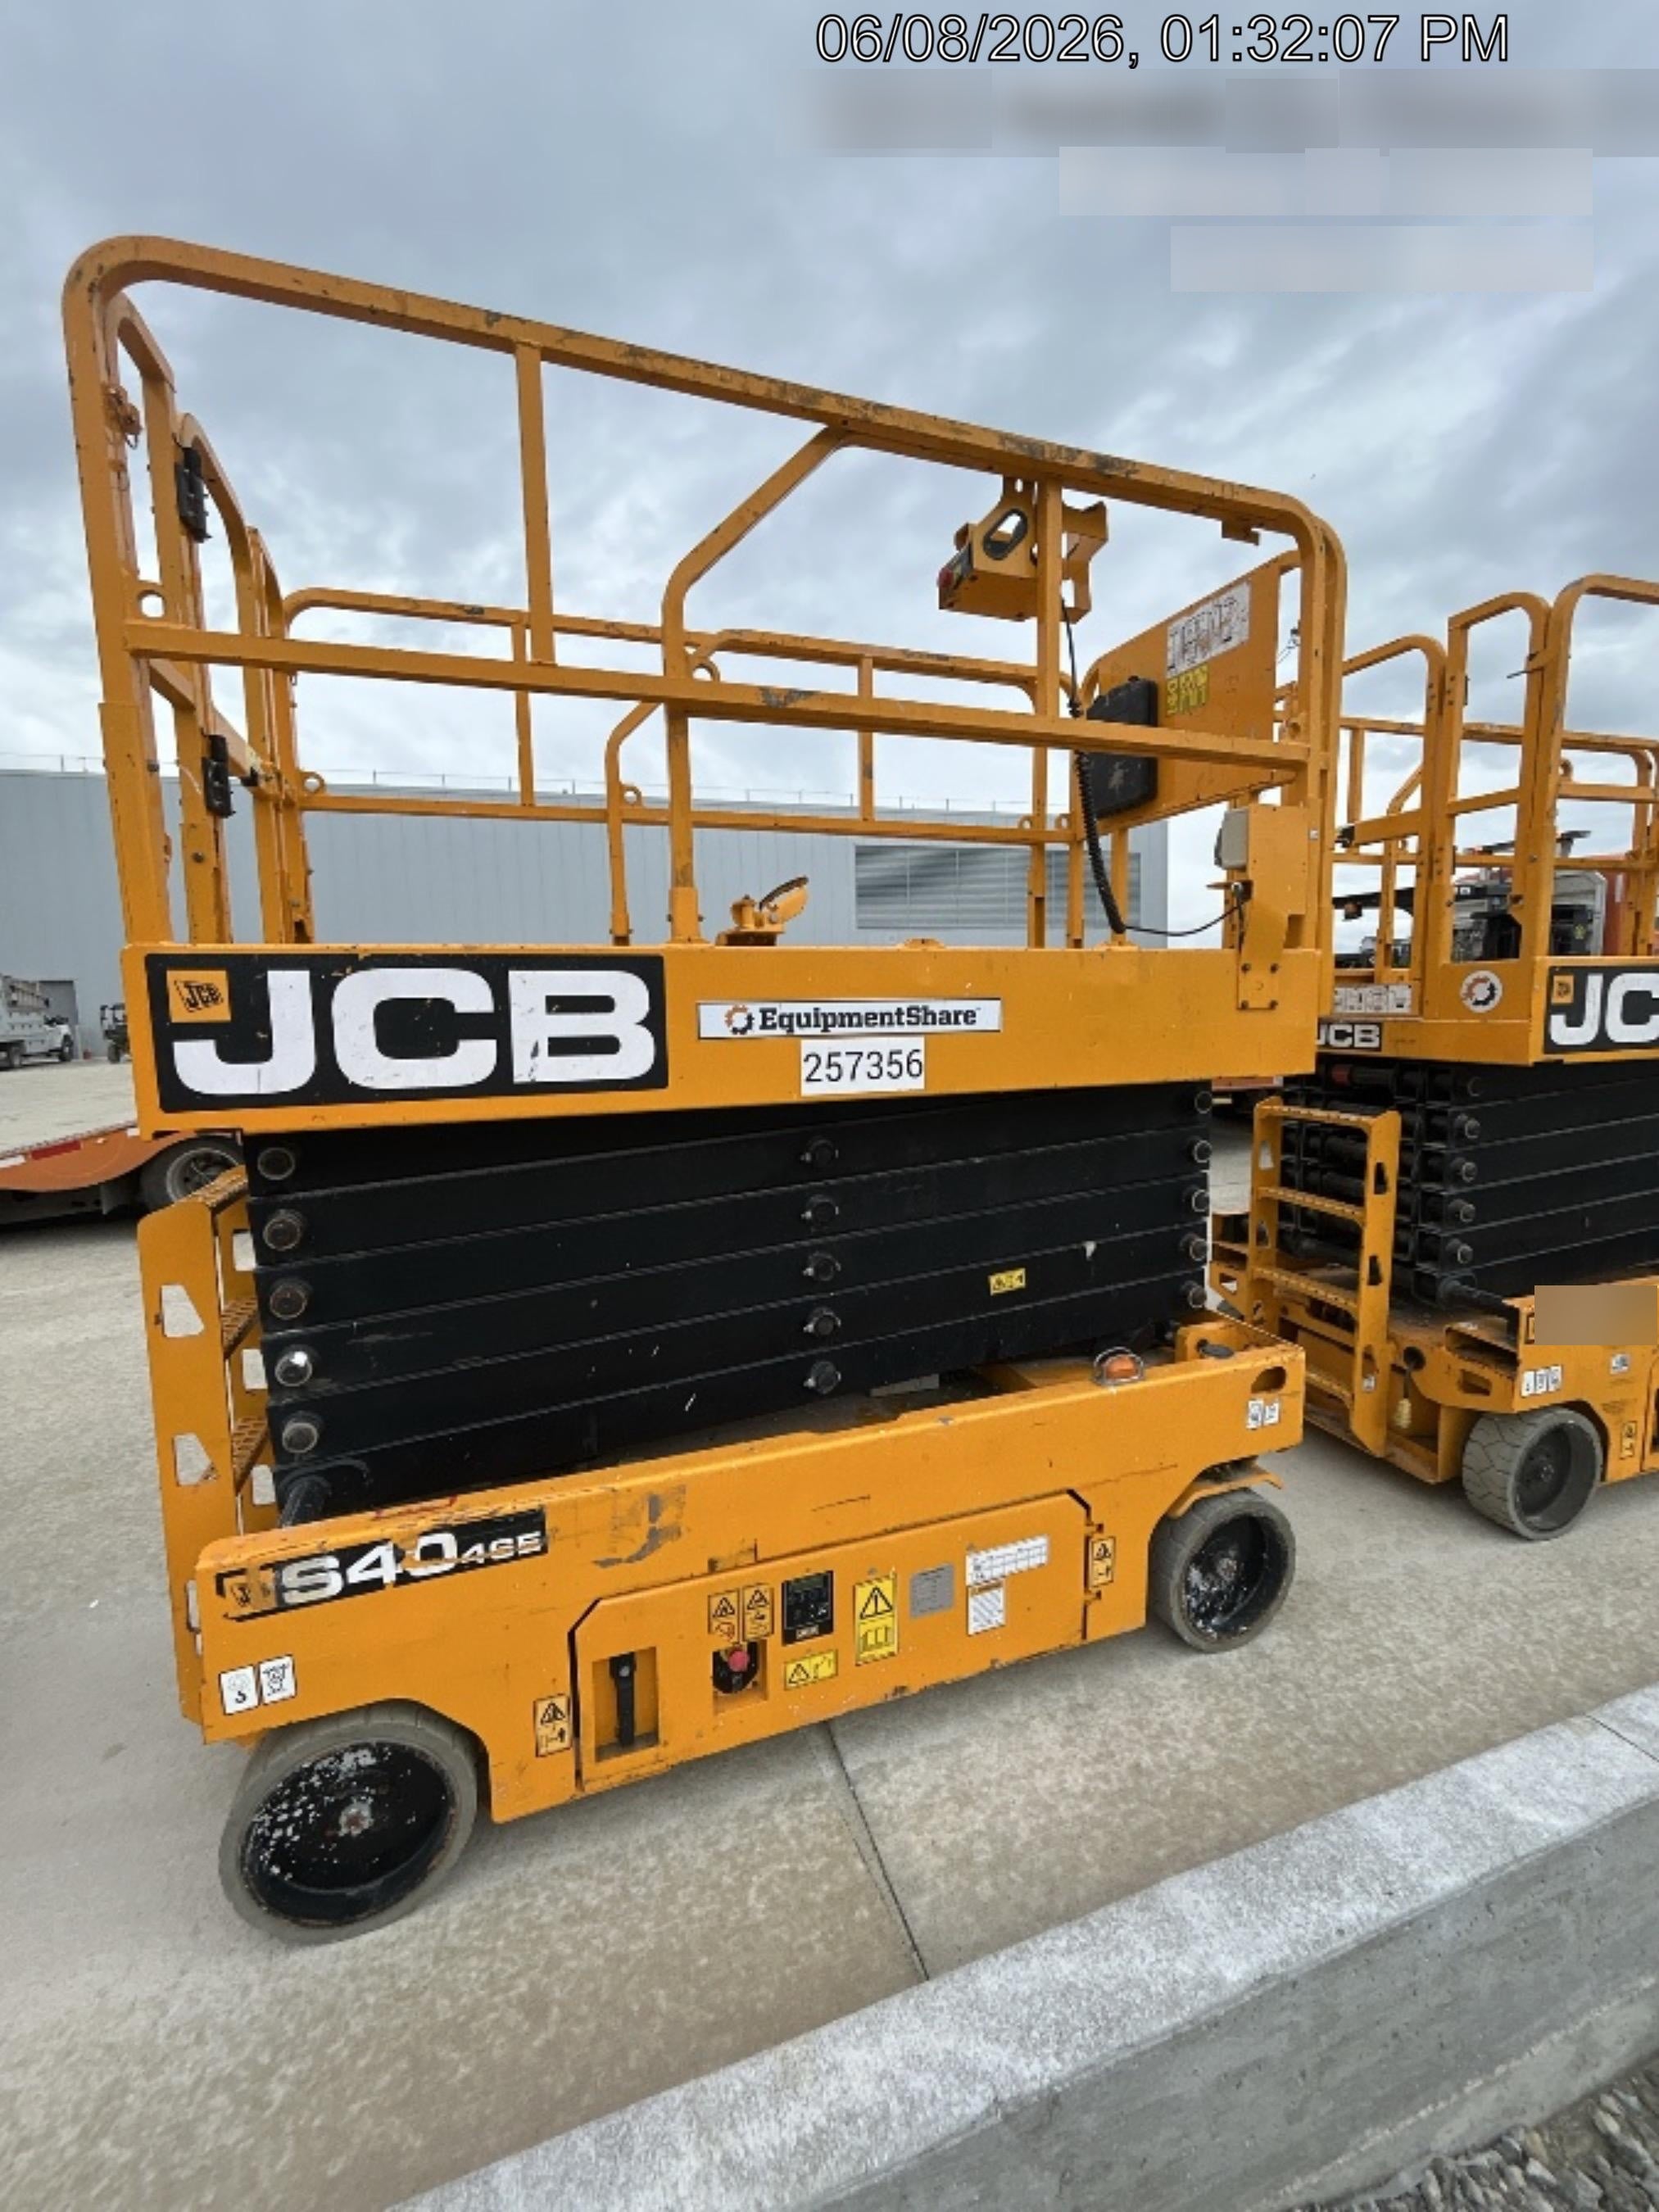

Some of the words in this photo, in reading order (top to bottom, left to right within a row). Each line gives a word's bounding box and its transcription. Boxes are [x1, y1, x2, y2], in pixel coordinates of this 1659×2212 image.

[173, 967, 656, 1096] JCB
[759, 1004, 977, 1034] EquipmentShare
[803, 1048, 922, 1083] 257356
